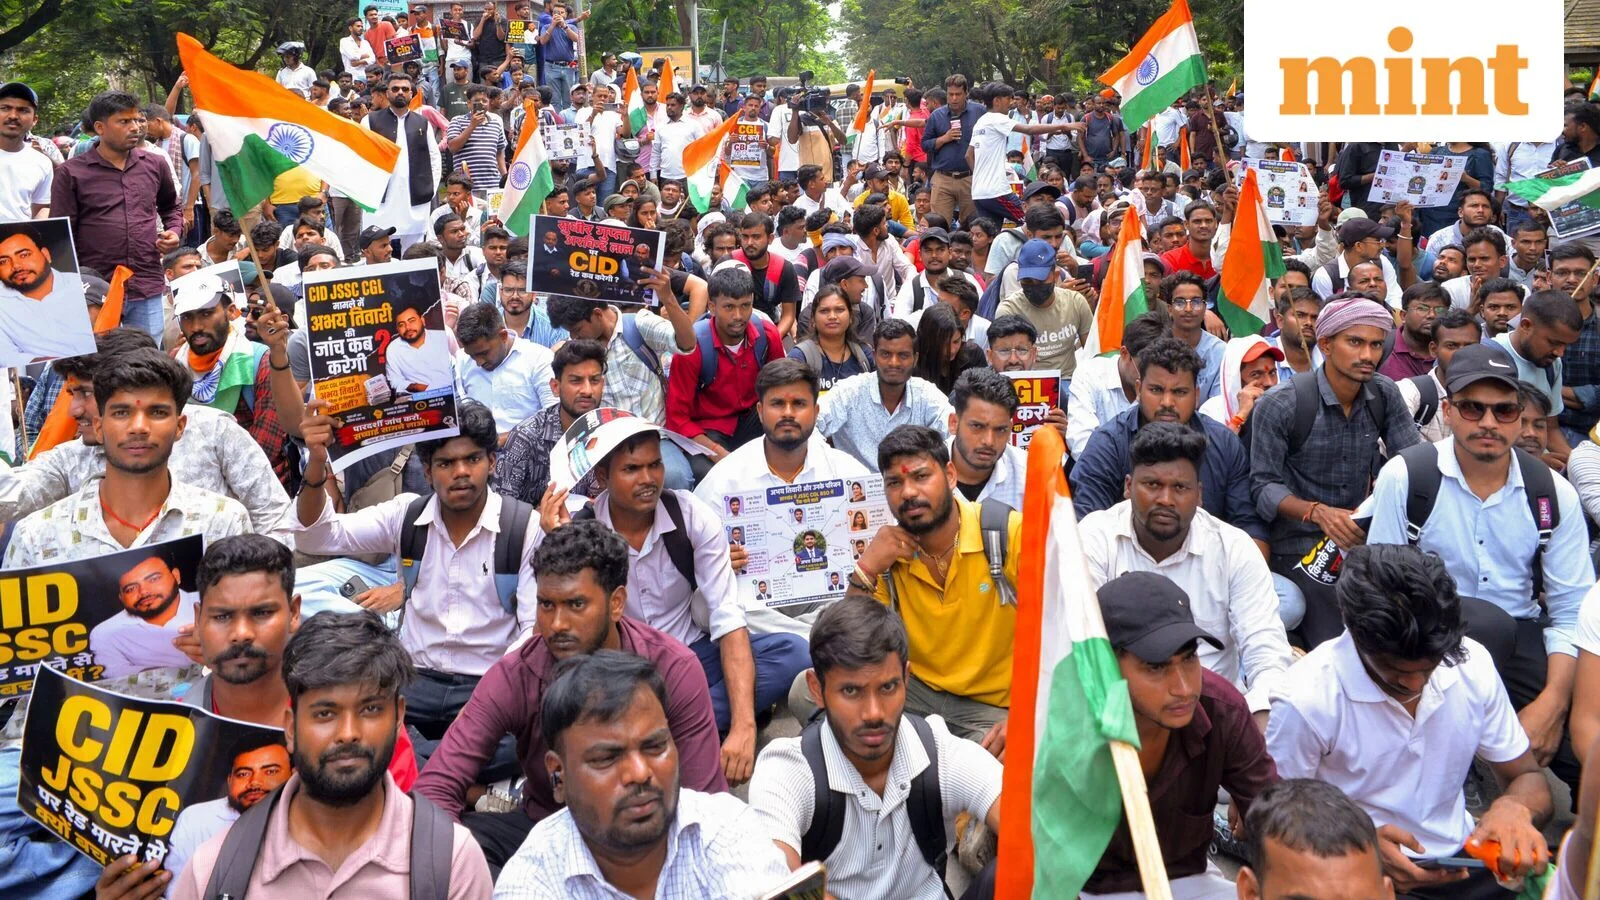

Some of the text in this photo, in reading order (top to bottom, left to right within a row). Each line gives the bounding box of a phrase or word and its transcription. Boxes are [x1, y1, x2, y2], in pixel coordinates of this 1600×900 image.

[510, 21, 524, 30] CID
[396, 45, 411, 54] CID
[738, 125, 760, 135] CGL
[734, 143, 748, 151] CBI
[558, 220, 635, 243] सुधीर गुप्ता,
[609, 242, 635, 255] लाल
[569, 251, 619, 276] CID
[570, 269, 580, 277] रेड
[581, 271, 594, 280] कब
[594, 271, 613, 283] करेगी
[308, 279, 385, 302] CID JSSC CGL
[332, 297, 366, 310] मामले में
[311, 302, 393, 332] अभय तिवारी
[344, 328, 356, 338] की
[313, 335, 374, 357] जांच कब
[326, 328, 391, 376] करेगी ?
[1013, 379, 1050, 404] GL
[1016, 402, 1051, 421] करो
[1307, 549, 1329, 578] किसके
[1324, 538, 1337, 553] दब
[0, 572, 78, 630] ID
[0, 623, 88, 665] SC
[14, 656, 69, 677] माने
[73, 652, 94, 667] से
[89, 664, 105, 681] ?
[55, 694, 196, 782] CID
[41, 755, 180, 837] JSSC
[35, 802, 108, 864] क्यों बच
[37, 784, 169, 865] पर रेड मारने से
